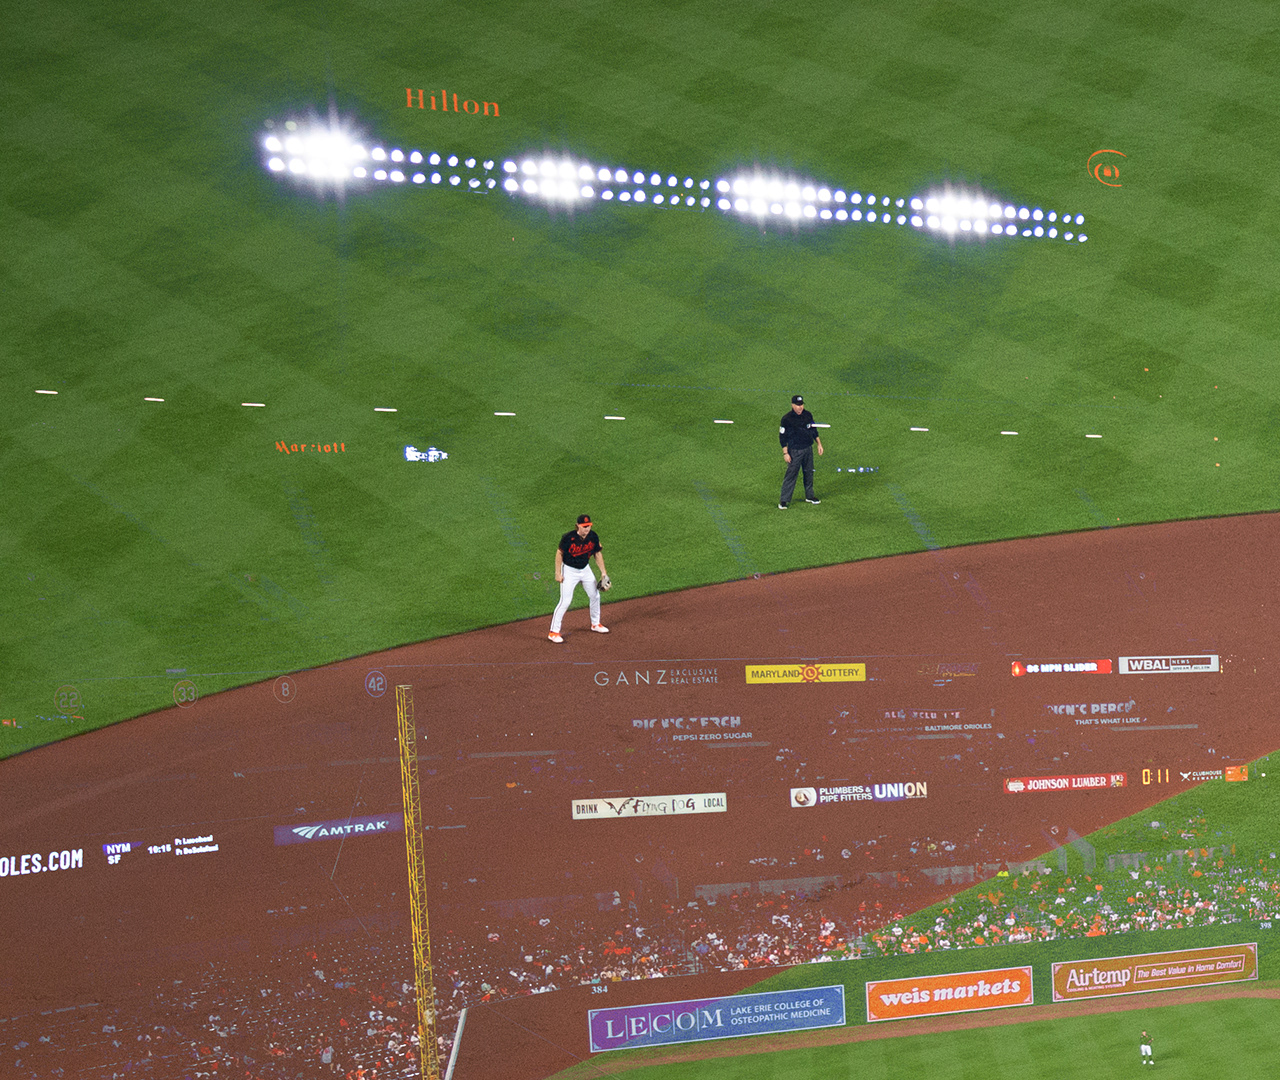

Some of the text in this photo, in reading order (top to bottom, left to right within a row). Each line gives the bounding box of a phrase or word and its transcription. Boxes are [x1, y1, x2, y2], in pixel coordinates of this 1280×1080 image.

[405, 88, 500, 117] Hilton
[1040, 663, 1098, 673] MPH SLIDER
[1129, 660, 1169, 671] WBAL
[594, 669, 668, 686] GANZ
[670, 668, 718, 676] EXCLUSIVE
[751, 668, 859, 679] MARYLAND LOTTERY
[670, 675, 718, 684] REAL ESTATE
[700, 733, 722, 741] ZERO
[723, 732, 753, 740] SUGAR
[1027, 777, 1107, 791] JOHNSON LUMBER
[820, 786, 864, 795] PLUMBERS
[874, 782, 927, 798] UNION
[820, 793, 873, 803] PIPE FITTERS
[576, 797, 724, 814] DRINK LOCAL
[319, 821, 386, 837] AMTRAK
[106, 843, 131, 854] NYM
[107, 855, 121, 865] SF
[1259, 922, 1272, 930] 398
[1138, 970, 1150, 978] The
[1151, 968, 1167, 977] Best
[1168, 966, 1186, 975] Value
[1196, 964, 1215, 972] Home
[1216, 960, 1242, 970] Comfort
[1067, 966, 1131, 989] Airtemp
[591, 986, 608, 995] 384
[880, 978, 1021, 1006] weis markets
[730, 999, 824, 1015] LAKE ERIE COLLEGE OF
[731, 1007, 831, 1025] OSTEOPATHIC MEDICINE
